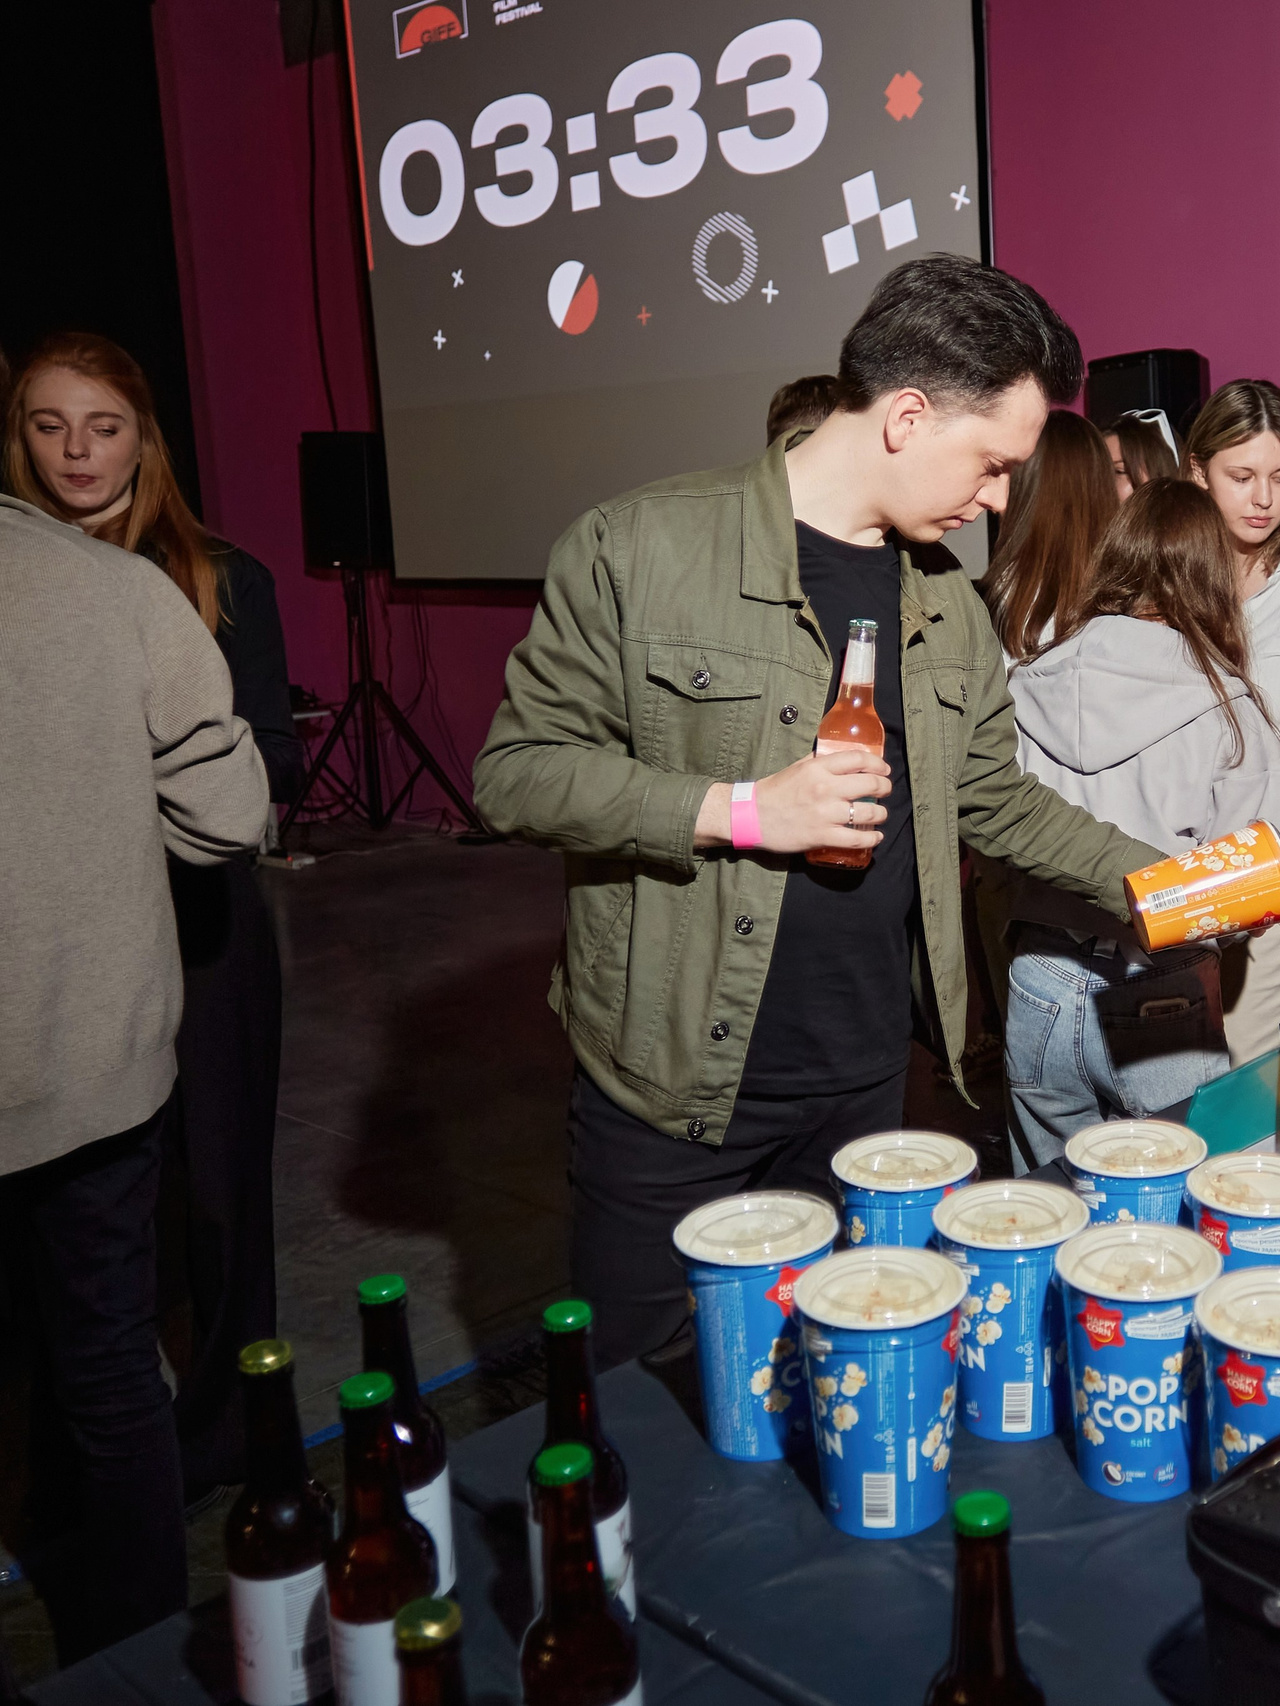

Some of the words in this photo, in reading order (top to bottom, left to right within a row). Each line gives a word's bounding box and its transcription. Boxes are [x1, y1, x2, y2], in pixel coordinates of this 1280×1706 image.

[495, 2, 544, 26] FESTIVAL
[379, 19, 829, 247] 03:33
[1174, 850, 1200, 871] RN
[778, 1290, 792, 1301] CO
[1086, 1314, 1116, 1330] HAPPY
[1086, 1323, 1112, 1337] CORN
[1227, 1368, 1258, 1387] HAPPY
[1227, 1378, 1253, 1394] CORN
[1108, 1375, 1179, 1406] POP
[1093, 1400, 1188, 1433] CORN
[1130, 1438, 1152, 1448] salt
